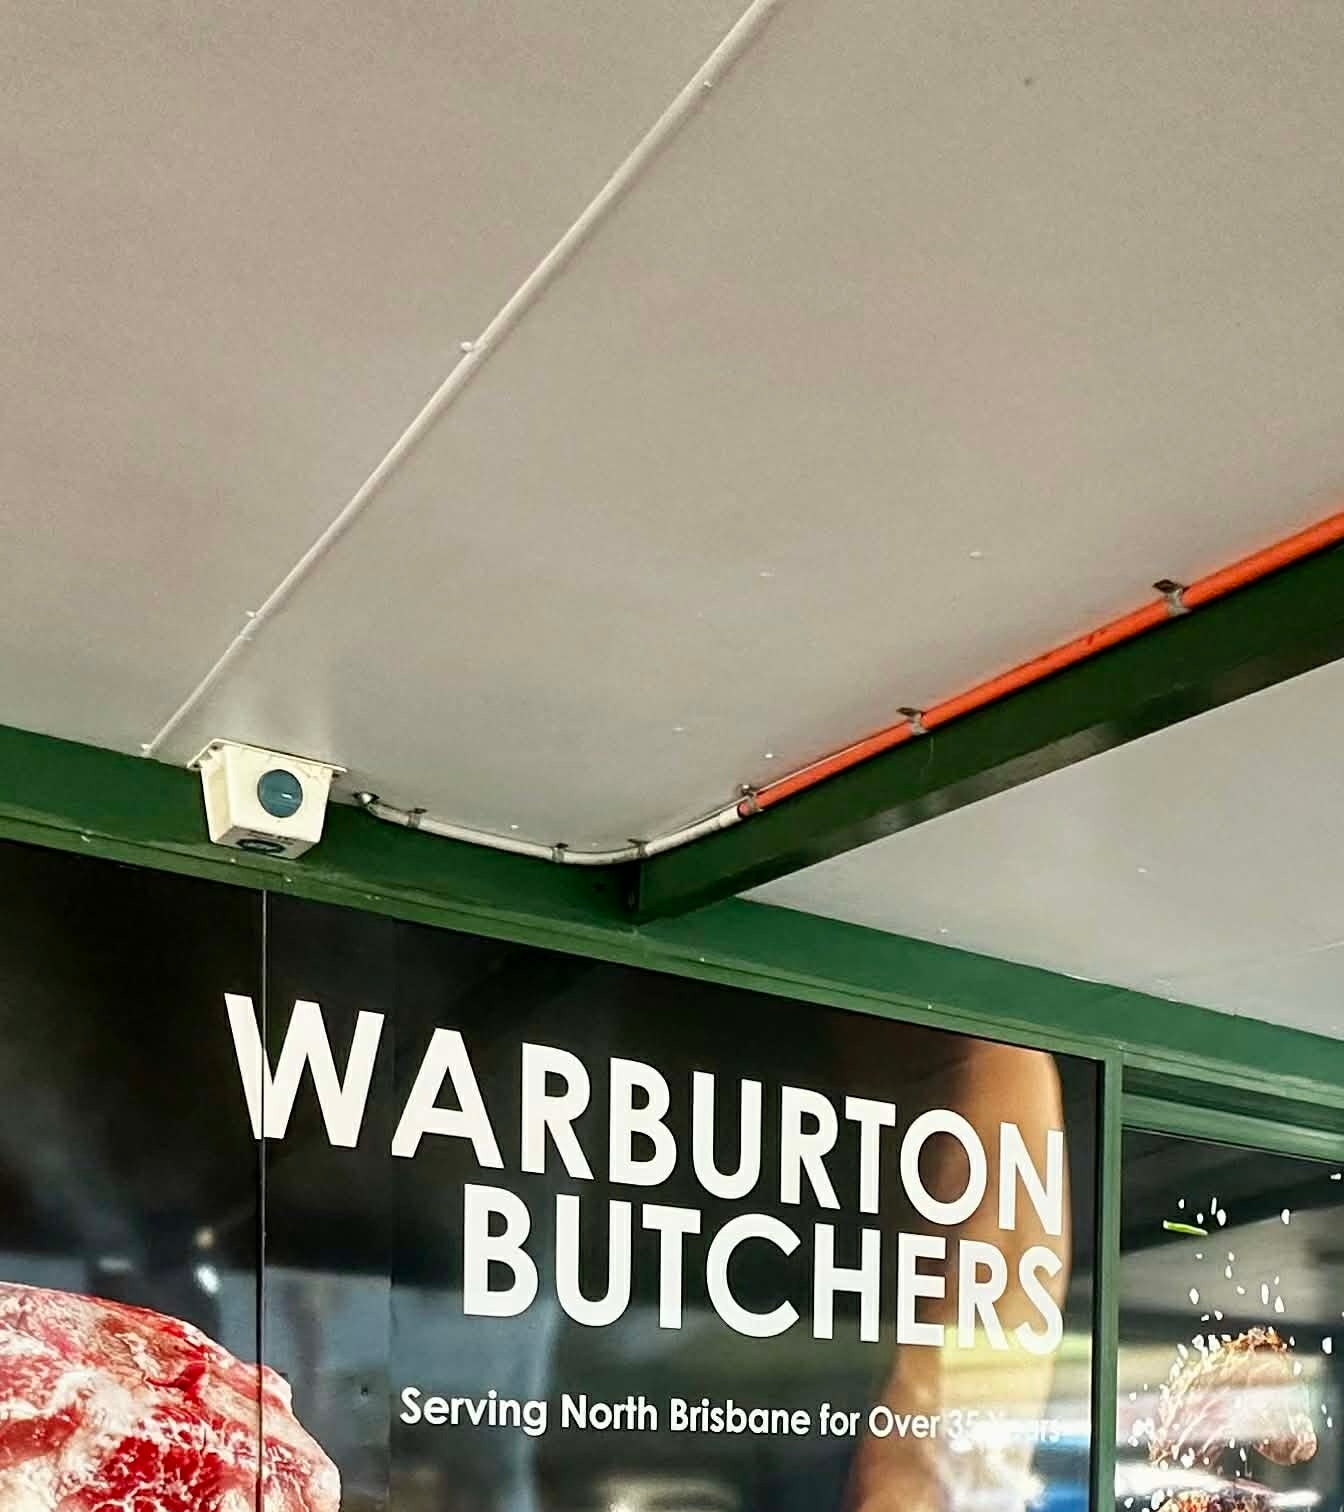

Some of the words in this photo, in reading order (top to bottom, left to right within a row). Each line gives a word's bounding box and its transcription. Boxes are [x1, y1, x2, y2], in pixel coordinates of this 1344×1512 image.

[224, 992, 1064, 1237] WARBURTON
[463, 1183, 1064, 1355] BUTCHERS
[399, 1386, 548, 1437] Serving
[561, 1393, 658, 1432] North
[670, 1397, 811, 1435] Brisbane
[819, 1402, 860, 1437] for
[868, 1405, 941, 1439] Over
